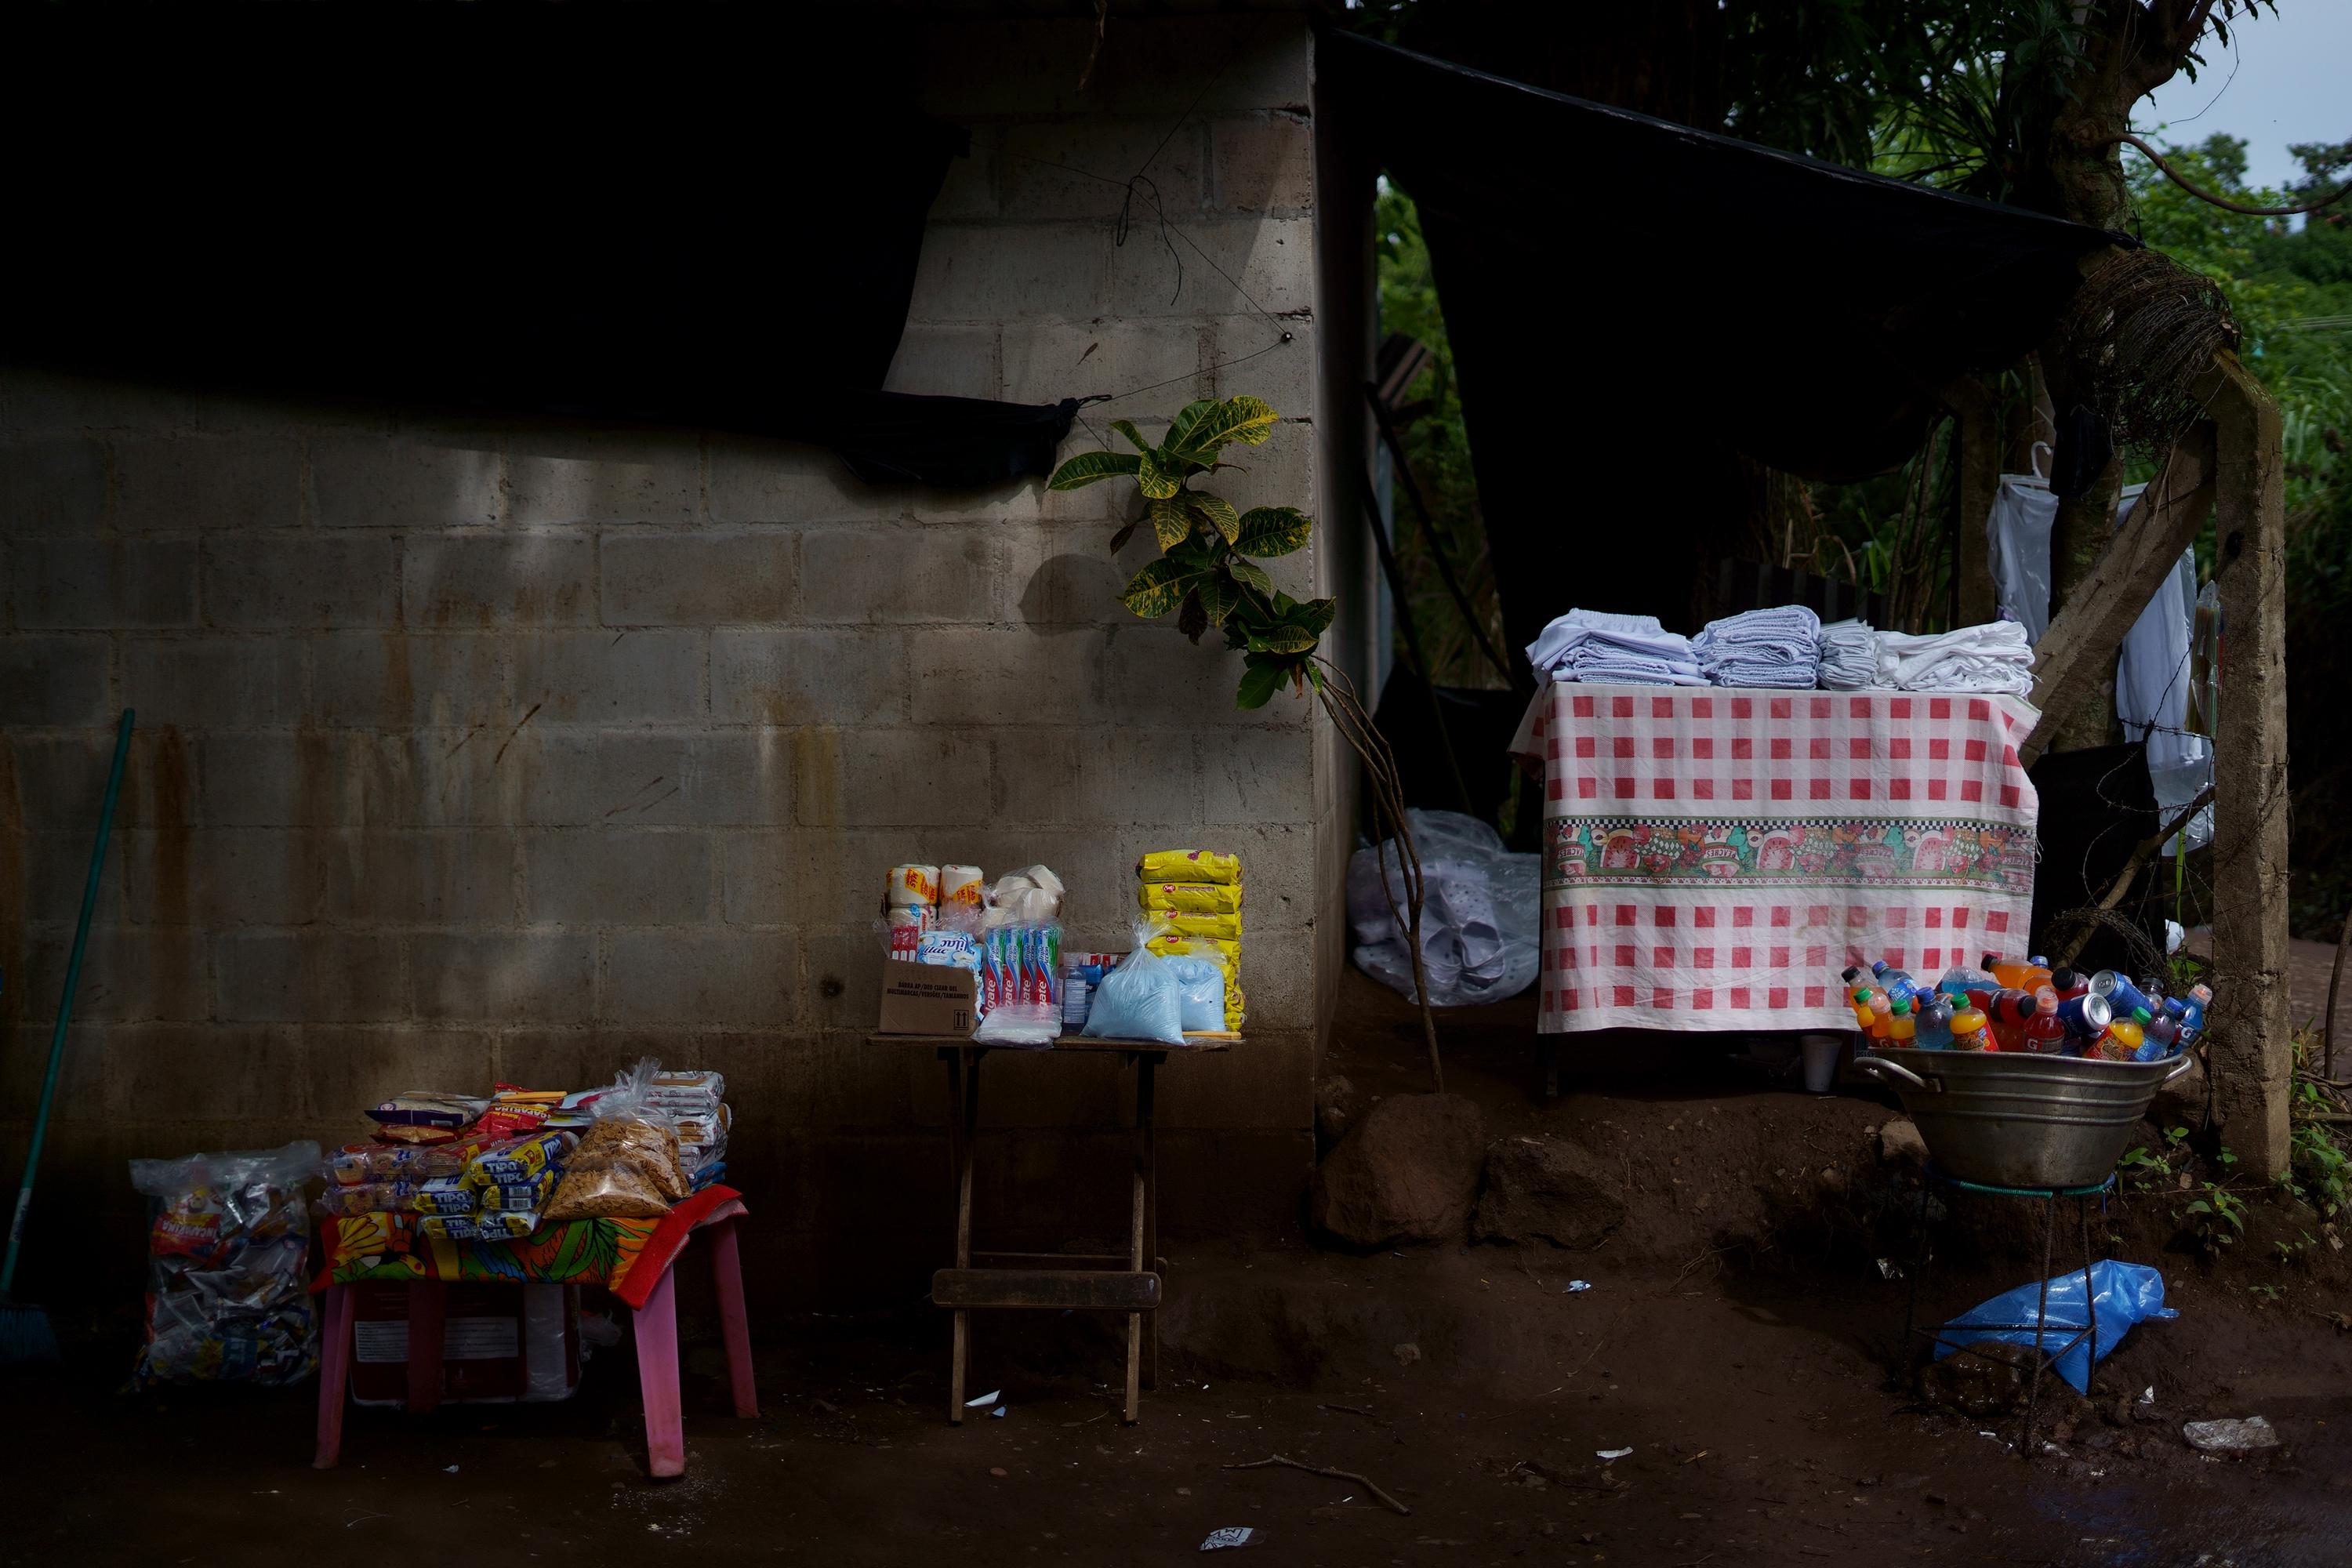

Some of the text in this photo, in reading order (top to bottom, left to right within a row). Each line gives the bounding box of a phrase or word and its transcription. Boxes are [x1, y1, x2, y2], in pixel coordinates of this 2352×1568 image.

[1558, 848, 1584, 858] EACHES
[1705, 846, 1737, 858] PEACHES
[985, 978, 996, 1011] lgate
[1005, 978, 1014, 1007] gate
[1023, 978, 1032, 1006] gate
[2181, 1027, 2194, 1039] G
[2027, 1038, 2038, 1050] G
[495, 1106, 553, 1119] NCAPARINA
[487, 1161, 517, 1172] TIPO
[435, 1192, 466, 1203] TIPO
[440, 1203, 470, 1213] TIPO
